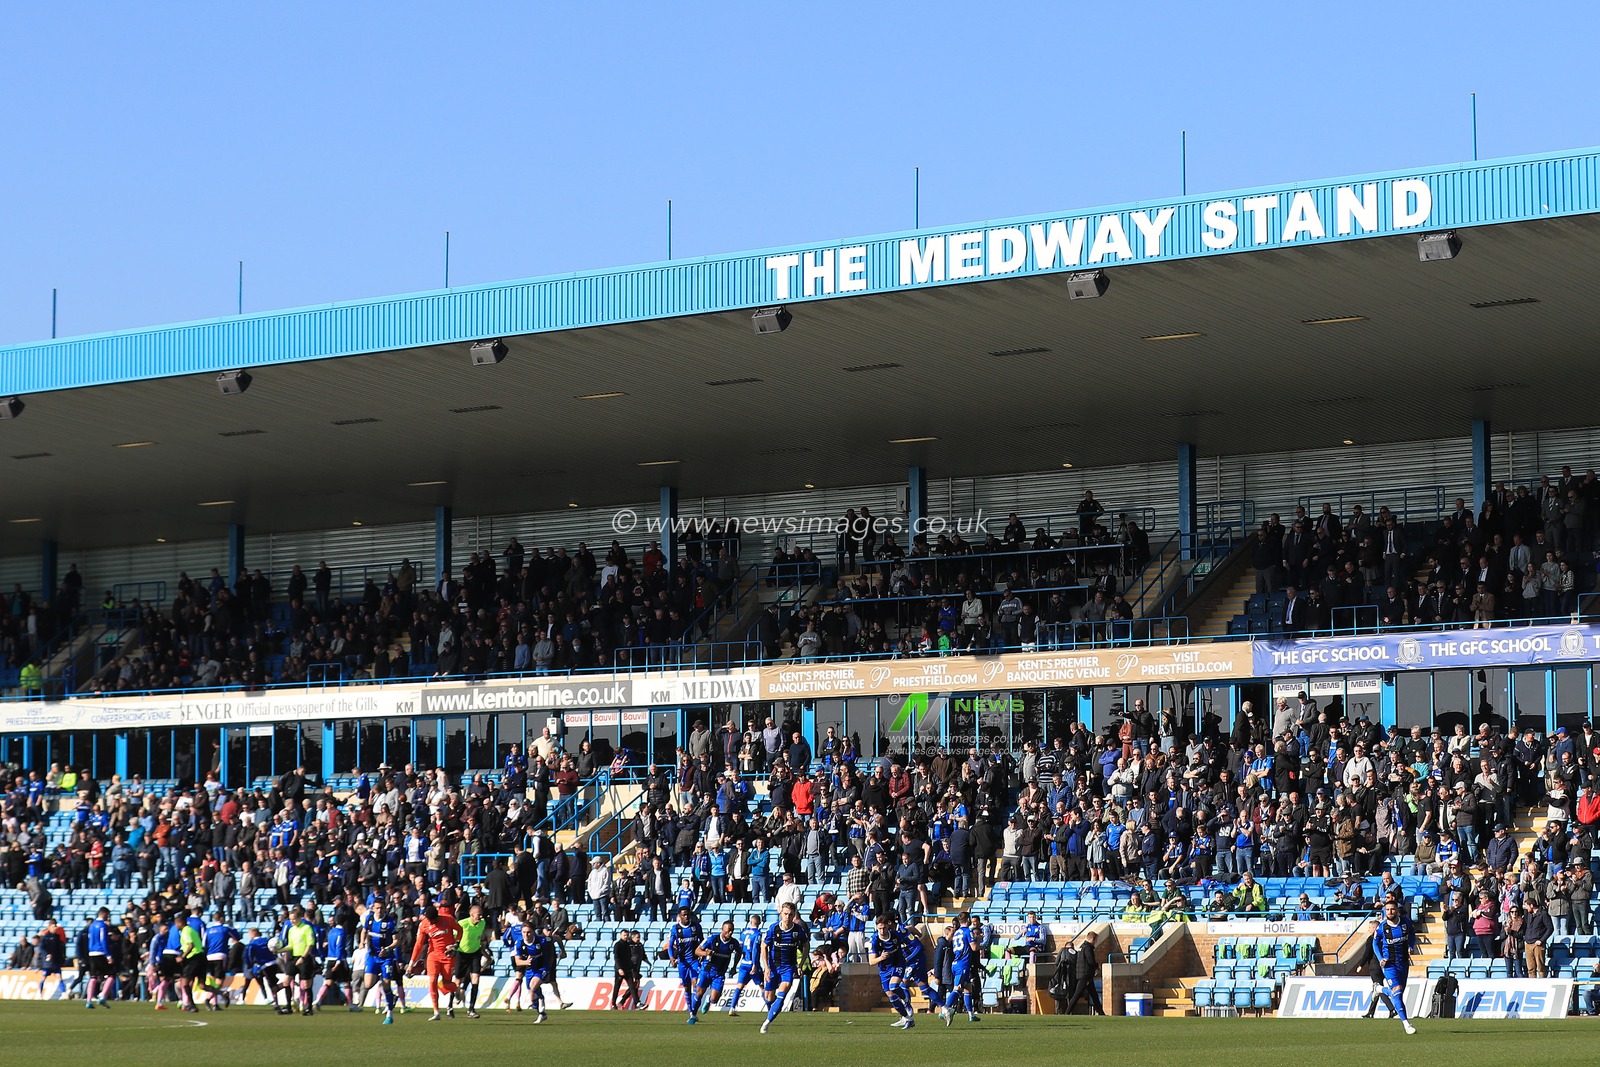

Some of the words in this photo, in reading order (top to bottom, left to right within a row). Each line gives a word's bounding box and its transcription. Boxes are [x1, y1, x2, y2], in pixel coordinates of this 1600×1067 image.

[766, 246, 867, 299] THE
[899, 208, 1175, 286] MEDWAY
[1201, 179, 1433, 249] STAND
[1429, 642, 1457, 657] THE
[1460, 640, 1488, 656] GFC
[1490, 637, 1551, 654] SCHOOL
[1173, 651, 1199, 663] VISIT
[1272, 651, 1299, 665] THE
[1301, 649, 1329, 664] GFC
[1331, 646, 1389, 662] SCHOOL
[922, 664, 948, 675] VISIT
[1017, 658, 1052, 671] KENT'S
[1054, 656, 1099, 668] PREMIER
[1141, 661, 1232, 676] PRIESTFIELD.COM
[779, 670, 811, 682] KENT'S
[813, 669, 854, 681] PREMIER
[893, 673, 977, 687] PRIESTFIELD.COM
[1006, 669, 1074, 683] BANQUETING
[1076, 667, 1110, 679] VENUE
[769, 681, 831, 694] BANQUETING
[833, 678, 865, 690] VENUE
[1314, 682, 1340, 690] MEMS
[1350, 680, 1377, 688] MEMS
[427, 682, 626, 712] www.kentonline.co.uk
[651, 690, 670, 703] KM
[682, 679, 756, 700] MEDWAY
[236, 701, 270, 717] Official
[273, 702, 323, 718] newspaper
[326, 698, 336, 713] of
[339, 698, 353, 712] the
[355, 696, 378, 711] Gills
[396, 701, 414, 714] KM
[147, 711, 171, 720] VENUE
[565, 714, 588, 722] Bauvill
[594, 713, 617, 722] Bauvill
[623, 712, 647, 721] Bauvill
[1263, 923, 1295, 933] HOME
[739, 988, 761, 998] BUIL
